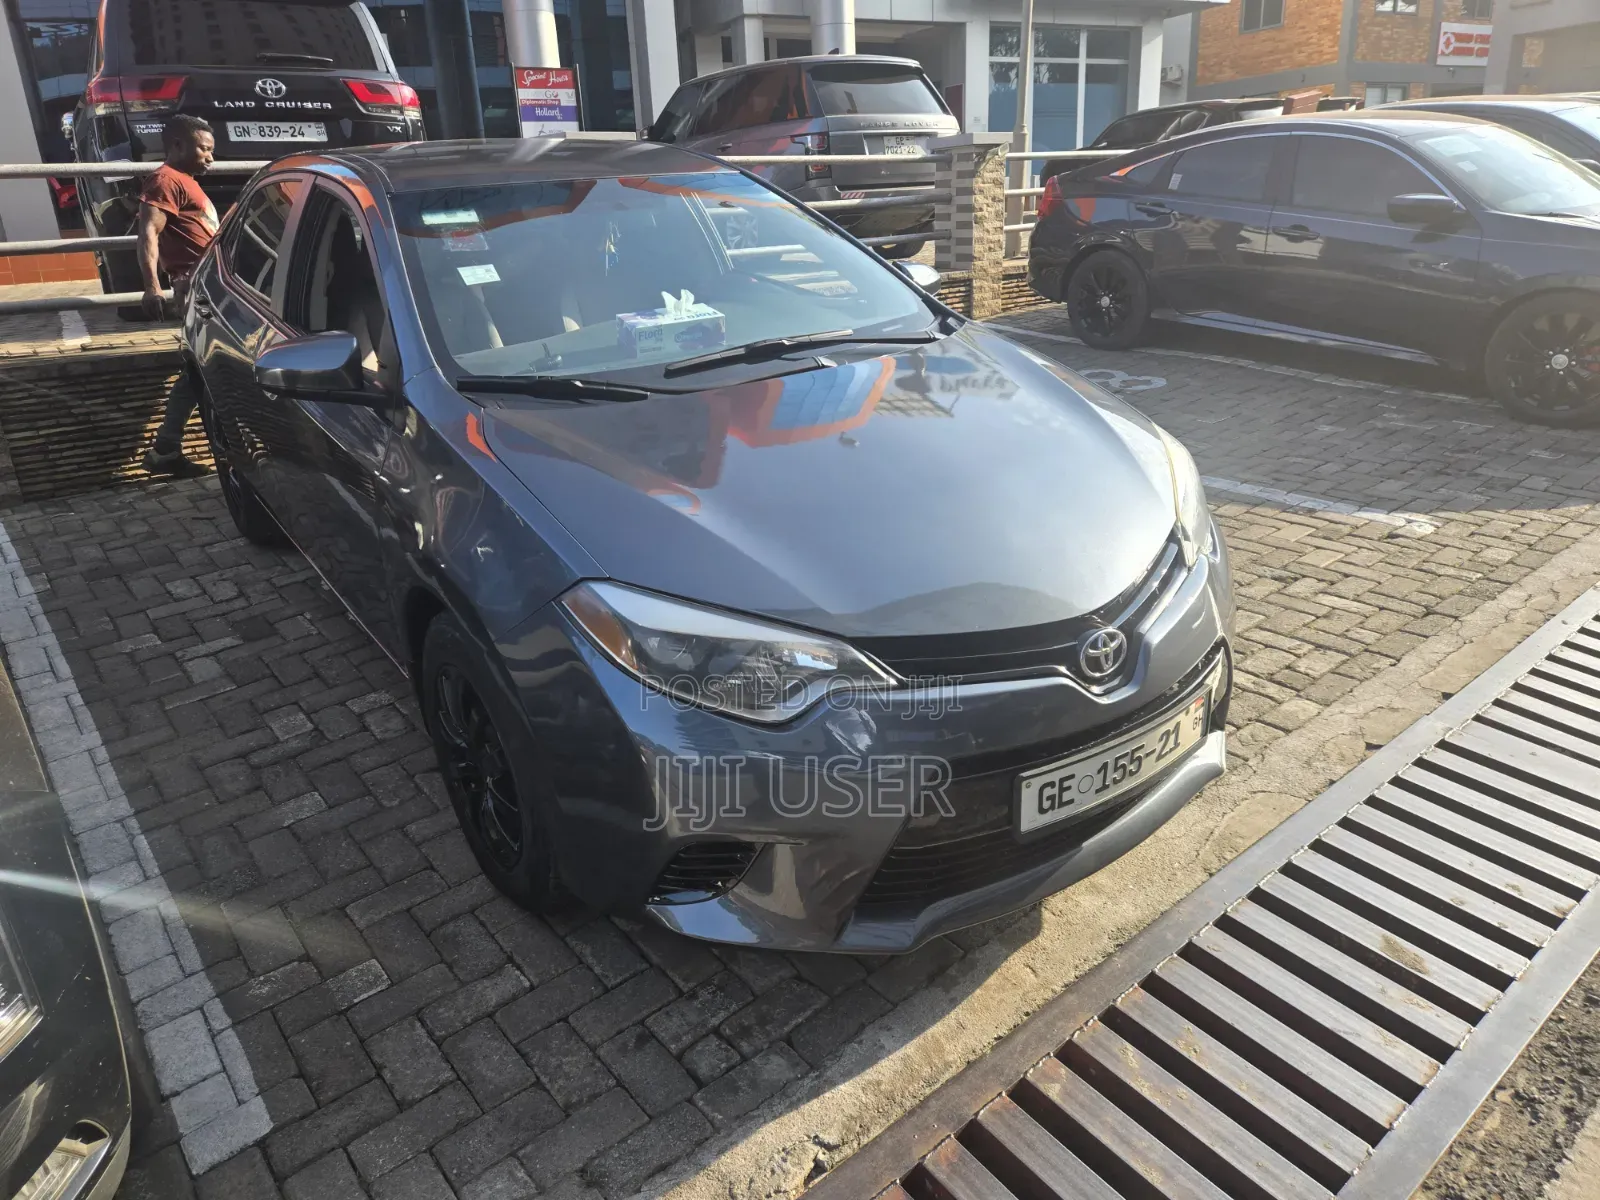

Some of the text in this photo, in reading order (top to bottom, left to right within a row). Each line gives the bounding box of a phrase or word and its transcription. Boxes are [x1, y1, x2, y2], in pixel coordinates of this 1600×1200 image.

[264, 101, 333, 109] CRUISER
[233, 125, 306, 138] GN 839-24
[386, 125, 403, 133] VX
[1037, 720, 1182, 815] GE 155-21
